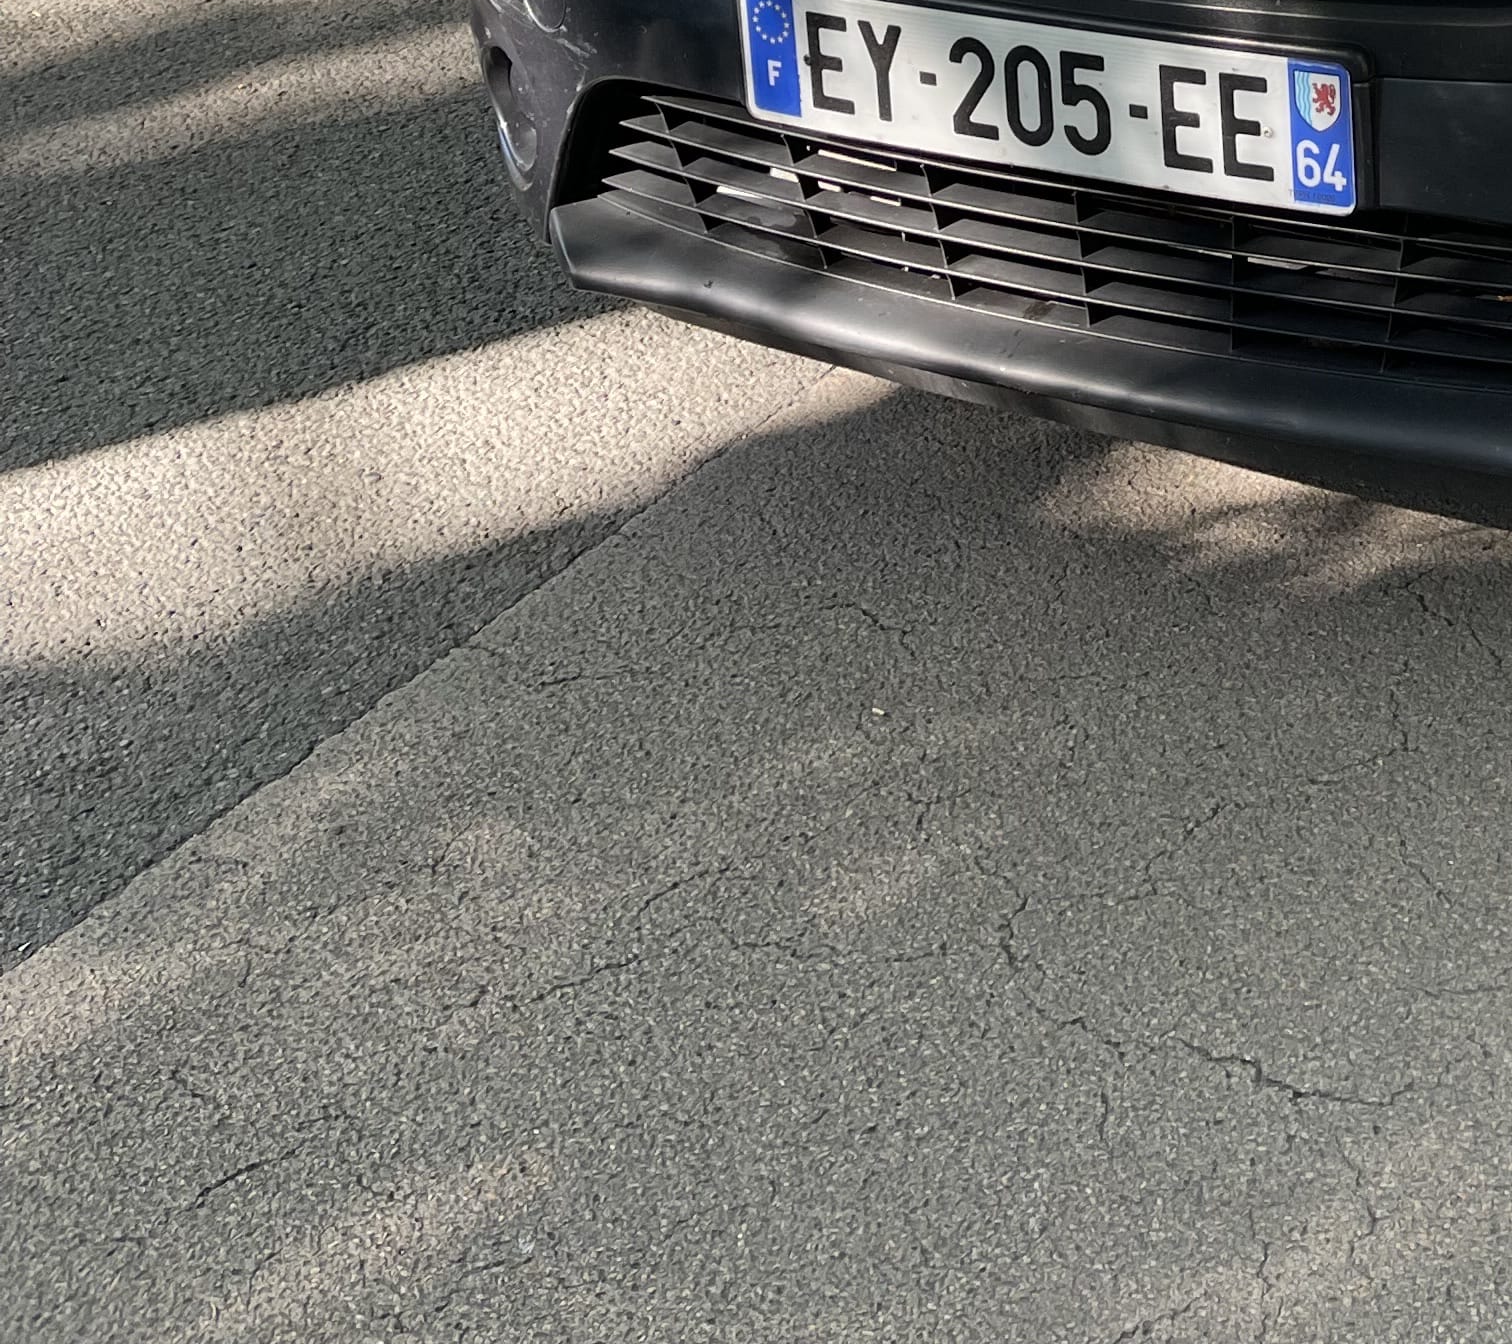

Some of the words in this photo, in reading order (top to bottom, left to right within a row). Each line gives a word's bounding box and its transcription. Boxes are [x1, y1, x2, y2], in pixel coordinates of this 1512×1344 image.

[767, 59, 782, 86] F
[805, 11, 1274, 182] EY-205-EE
[1296, 139, 1347, 192] 64
